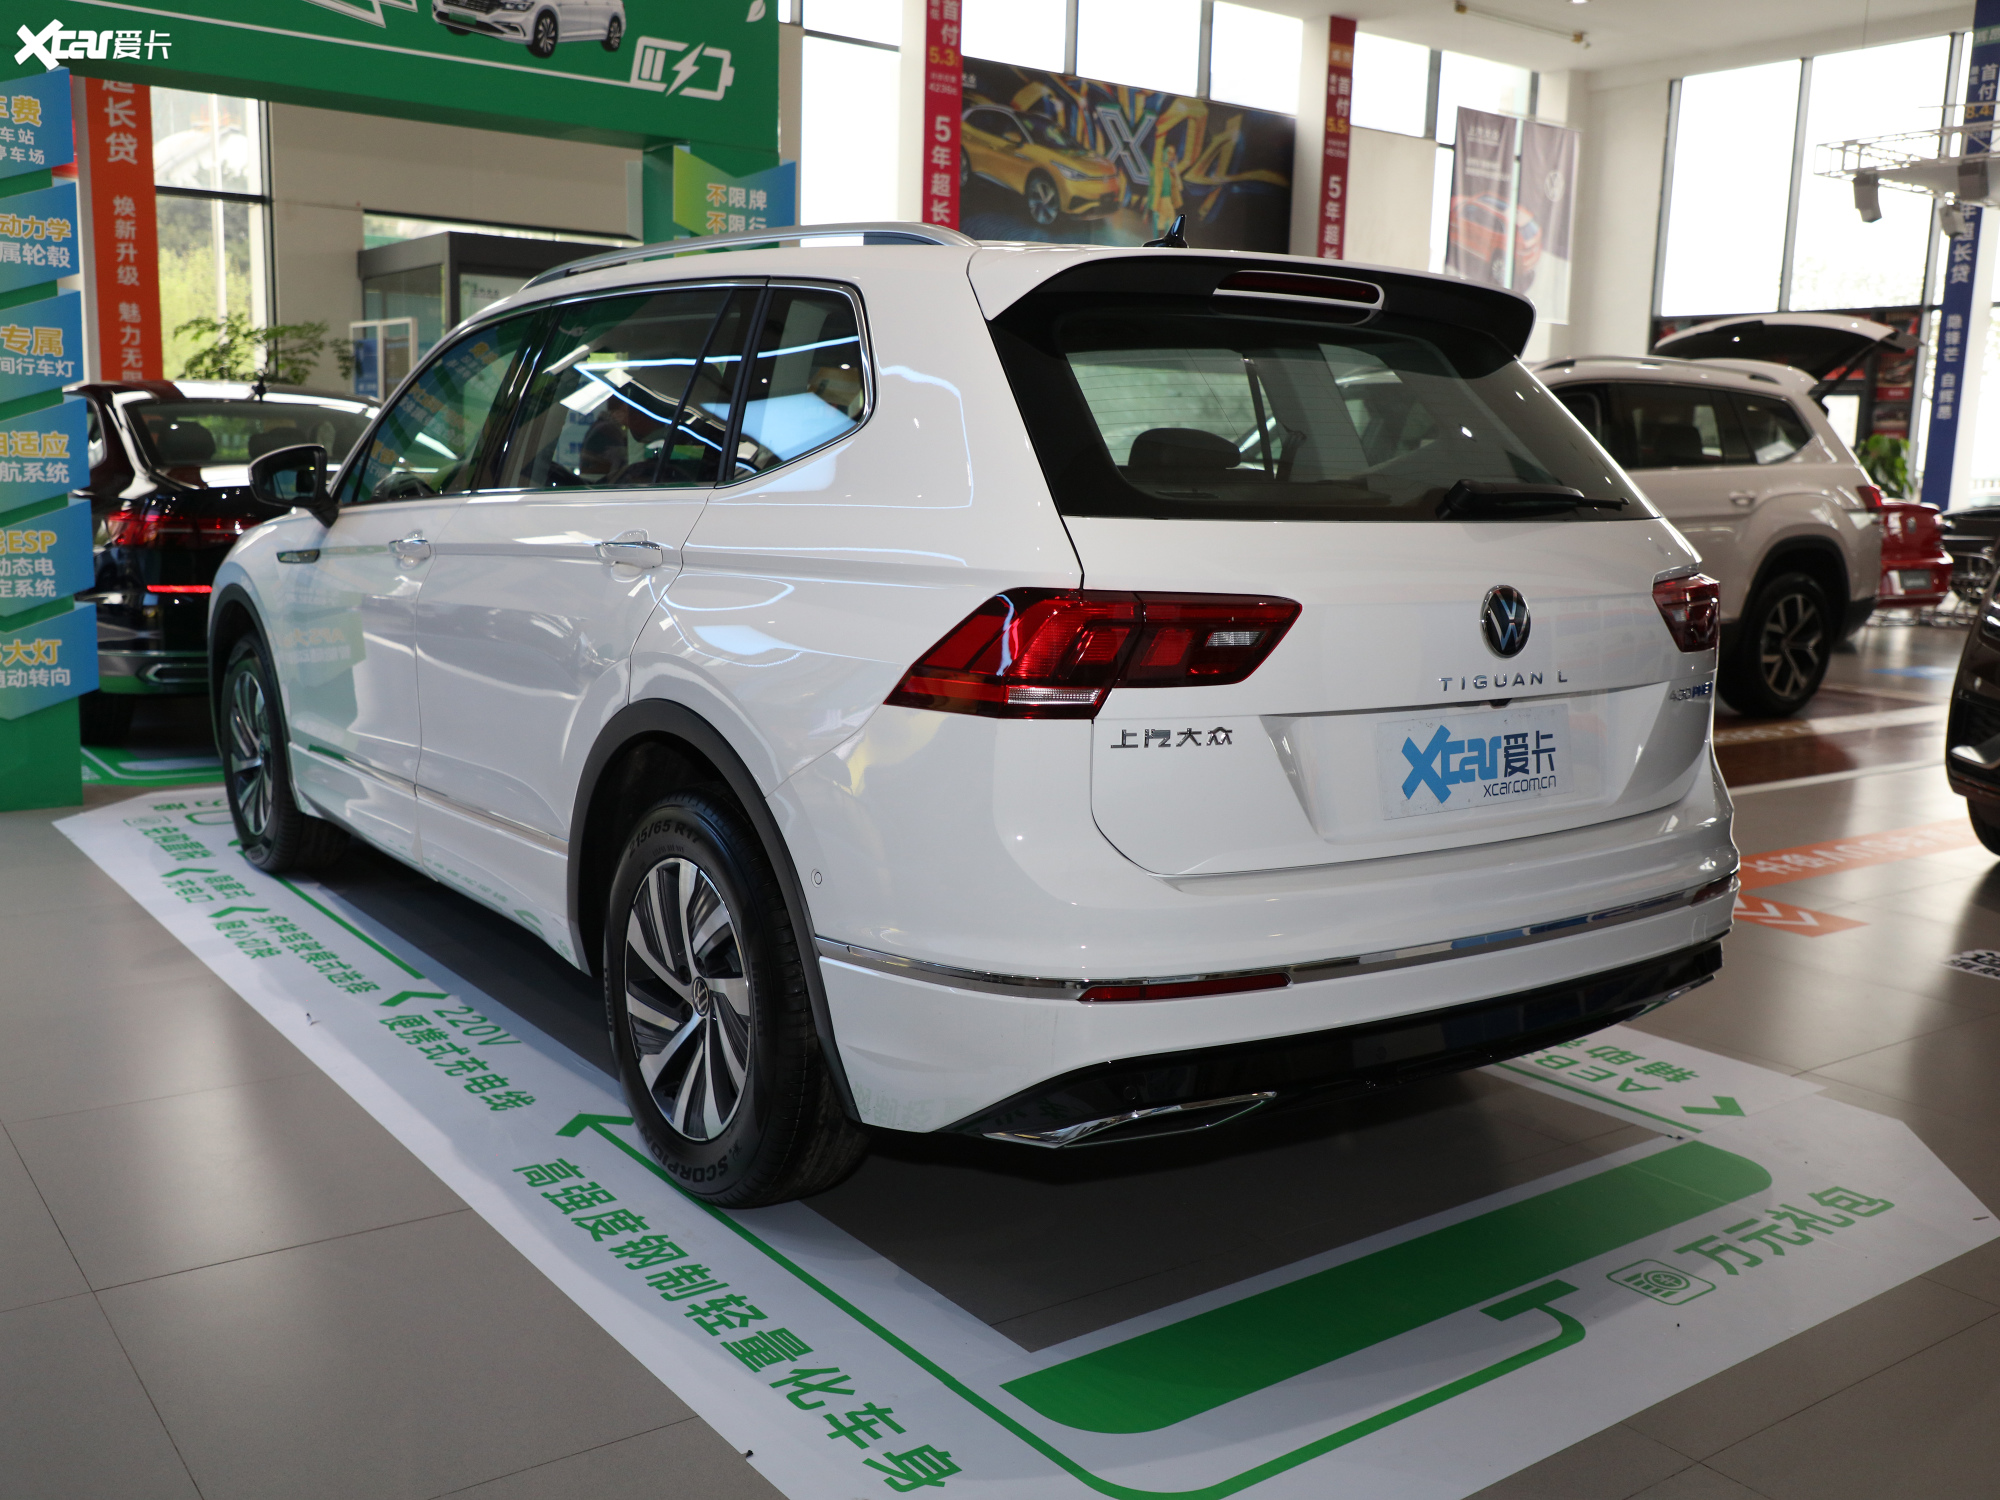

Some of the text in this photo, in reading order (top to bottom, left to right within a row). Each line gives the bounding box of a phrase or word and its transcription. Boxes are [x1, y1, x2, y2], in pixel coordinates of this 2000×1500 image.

[1978, 63, 1998, 101] 首付
[930, 115, 952, 224] 5年超长
[706, 183, 767, 211] 不限牌
[112, 195, 140, 287] 焕新升级
[0, 325, 64, 357] 专属
[0, 529, 57, 555] ESP
[0, 639, 62, 667] 大灯
[1439, 670, 1568, 691] TIGUAN L
[1111, 727, 1233, 749] 上汽大众
[1402, 725, 1556, 804] Xcar 爱卡
[1484, 776, 1557, 797] xcar.com.cn
[433, 1006, 522, 1046] 220V
[379, 1014, 537, 1112] 便携式充电线
[1523, 1050, 1663, 1092] AEB
[640, 1126, 728, 1183] SCORPION
[1673, 1186, 1895, 1276] 万元礼包
[512, 1157, 963, 1493] 高强度钢制轻量化车身
